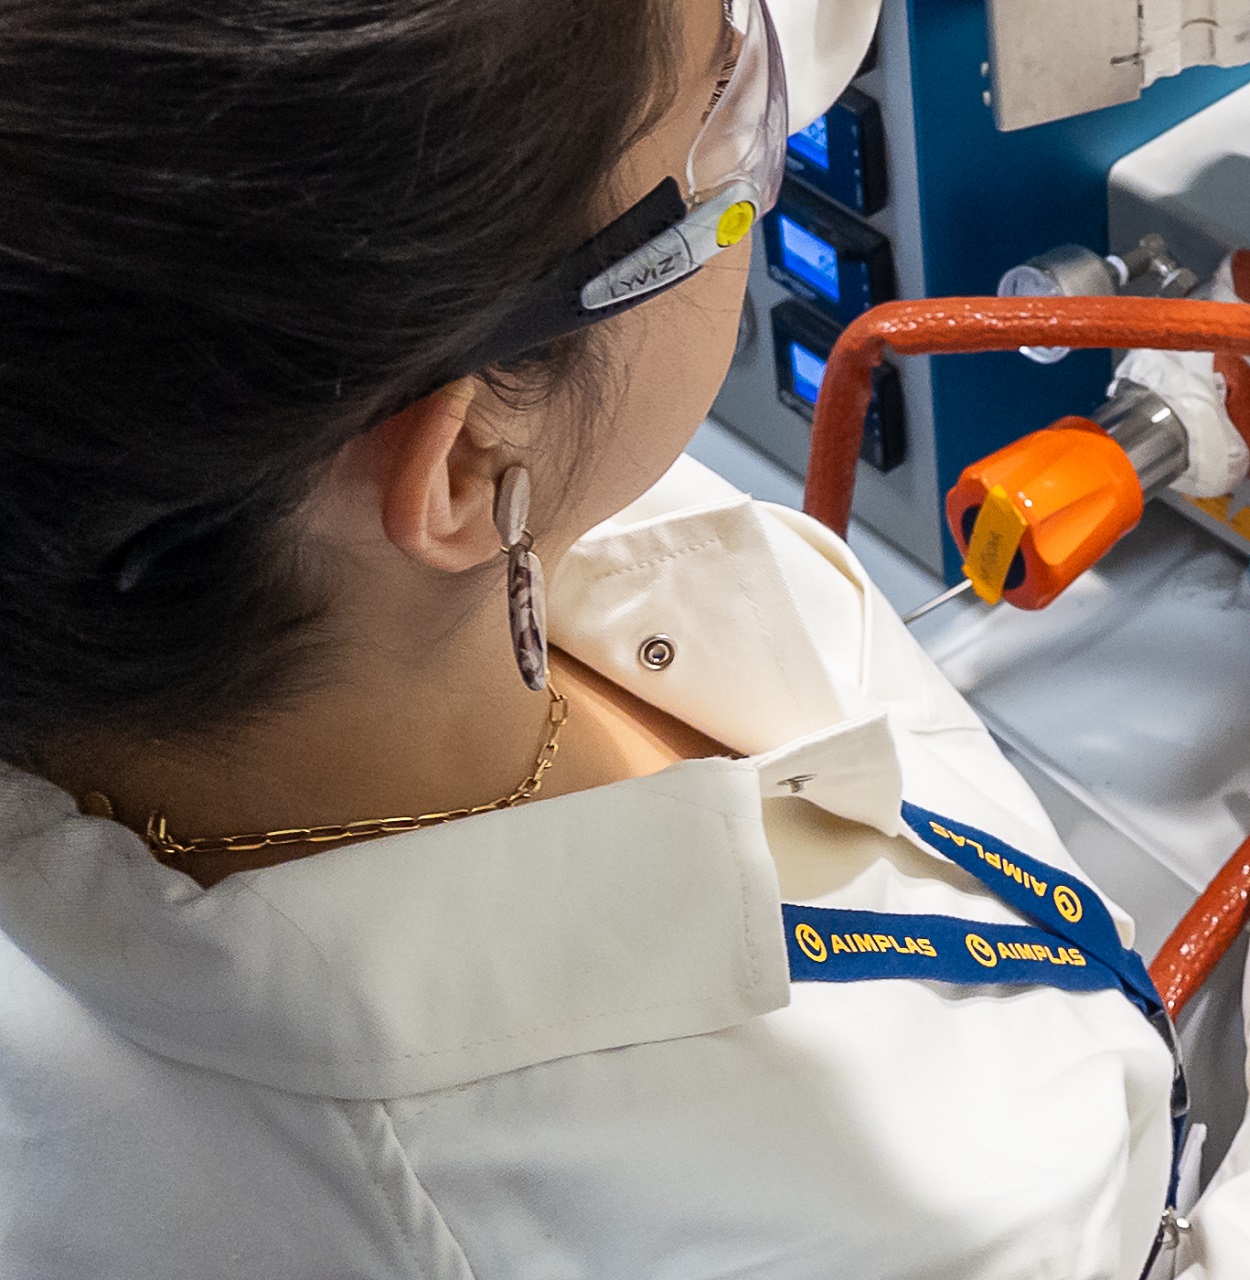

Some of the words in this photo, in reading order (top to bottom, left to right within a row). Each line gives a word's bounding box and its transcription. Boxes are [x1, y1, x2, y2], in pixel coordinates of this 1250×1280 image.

[928, 820, 1048, 897] AIMPLAS
[831, 933, 938, 958] AIMPLAS
[998, 941, 1087, 967] AIMPLAS
